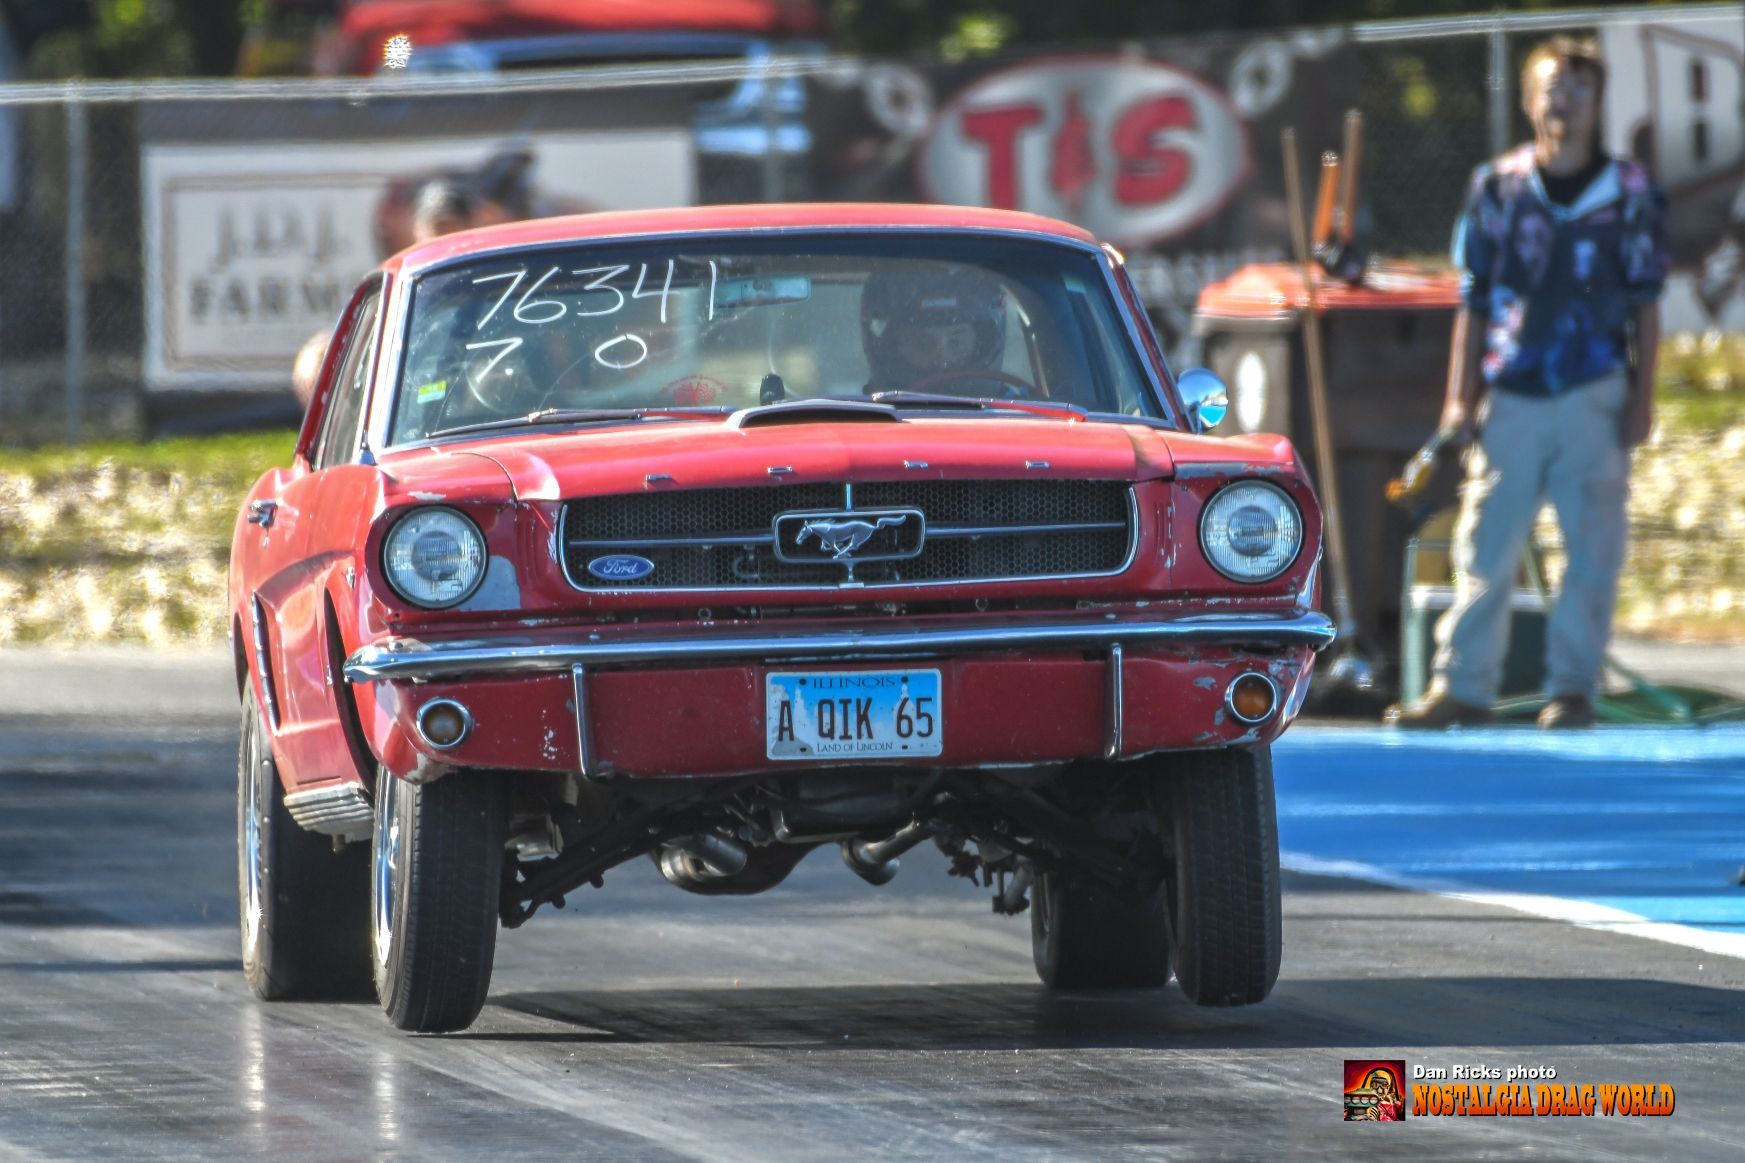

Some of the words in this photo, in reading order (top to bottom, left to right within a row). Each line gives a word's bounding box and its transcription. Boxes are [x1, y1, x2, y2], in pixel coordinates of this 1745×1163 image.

[472, 258, 717, 330] 76341
[603, 560, 638, 574] Ford
[813, 675, 896, 689] ILLINOIS
[778, 699, 794, 741] A
[818, 697, 873, 740] QIK
[896, 697, 933, 738] 65
